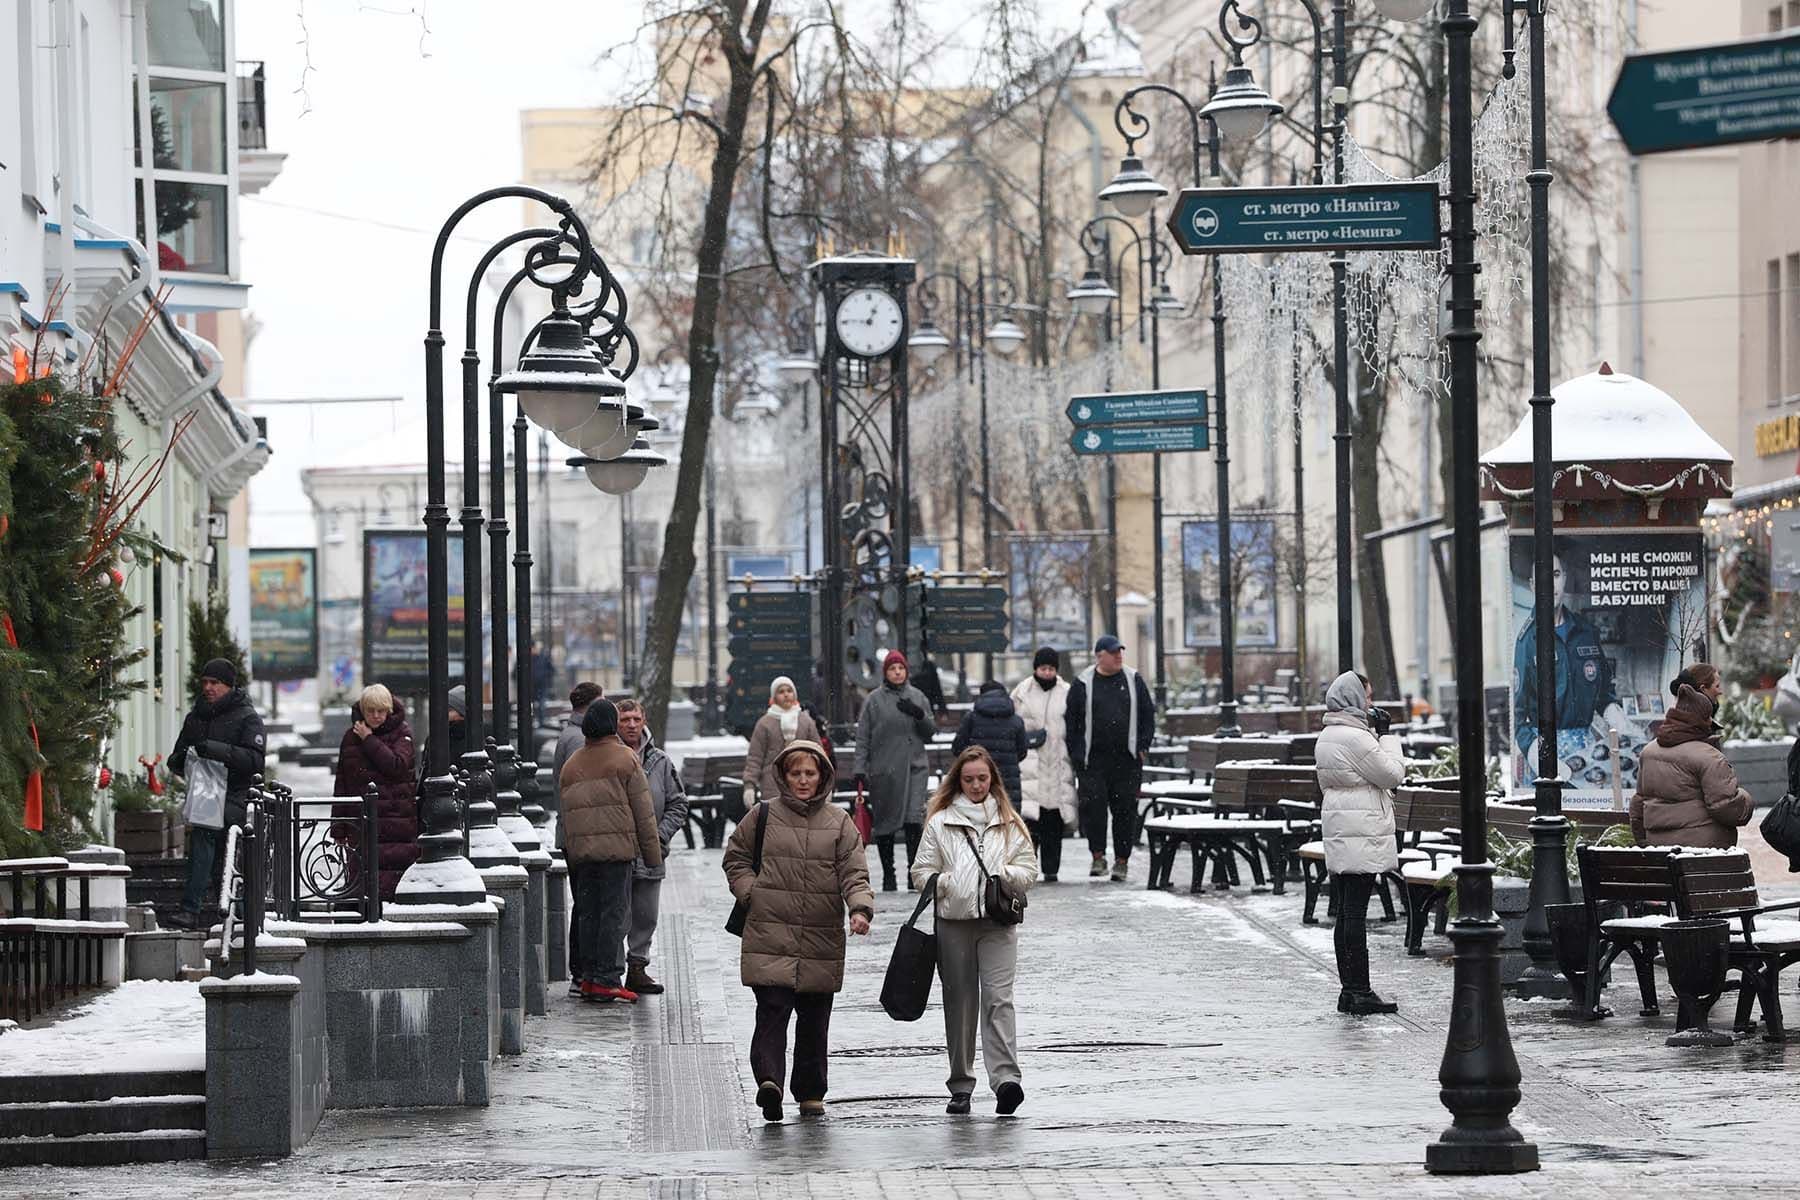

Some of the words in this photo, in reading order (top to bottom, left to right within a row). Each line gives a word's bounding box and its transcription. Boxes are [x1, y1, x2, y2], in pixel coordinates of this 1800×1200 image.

[1243, 203, 1265, 216] ст.
[1270, 202, 1319, 218] метро
[1325, 197, 1400, 214] «Няміга»
[1263, 229, 1283, 241] ст.
[1286, 229, 1328, 243] метро
[1332, 226, 1402, 240] «Немига»
[1590, 553, 1616, 564] МЫ
[1621, 552, 1640, 564] НЕ
[1643, 552, 1692, 563] СМОЖЕМ
[1590, 567, 1648, 578] ИСПЕЧЬ
[1652, 565, 1698, 577] ПИРОЖКИ
[1591, 581, 1649, 592] ВМЕСТО
[1591, 594, 1666, 606] БАБУШКИ!
